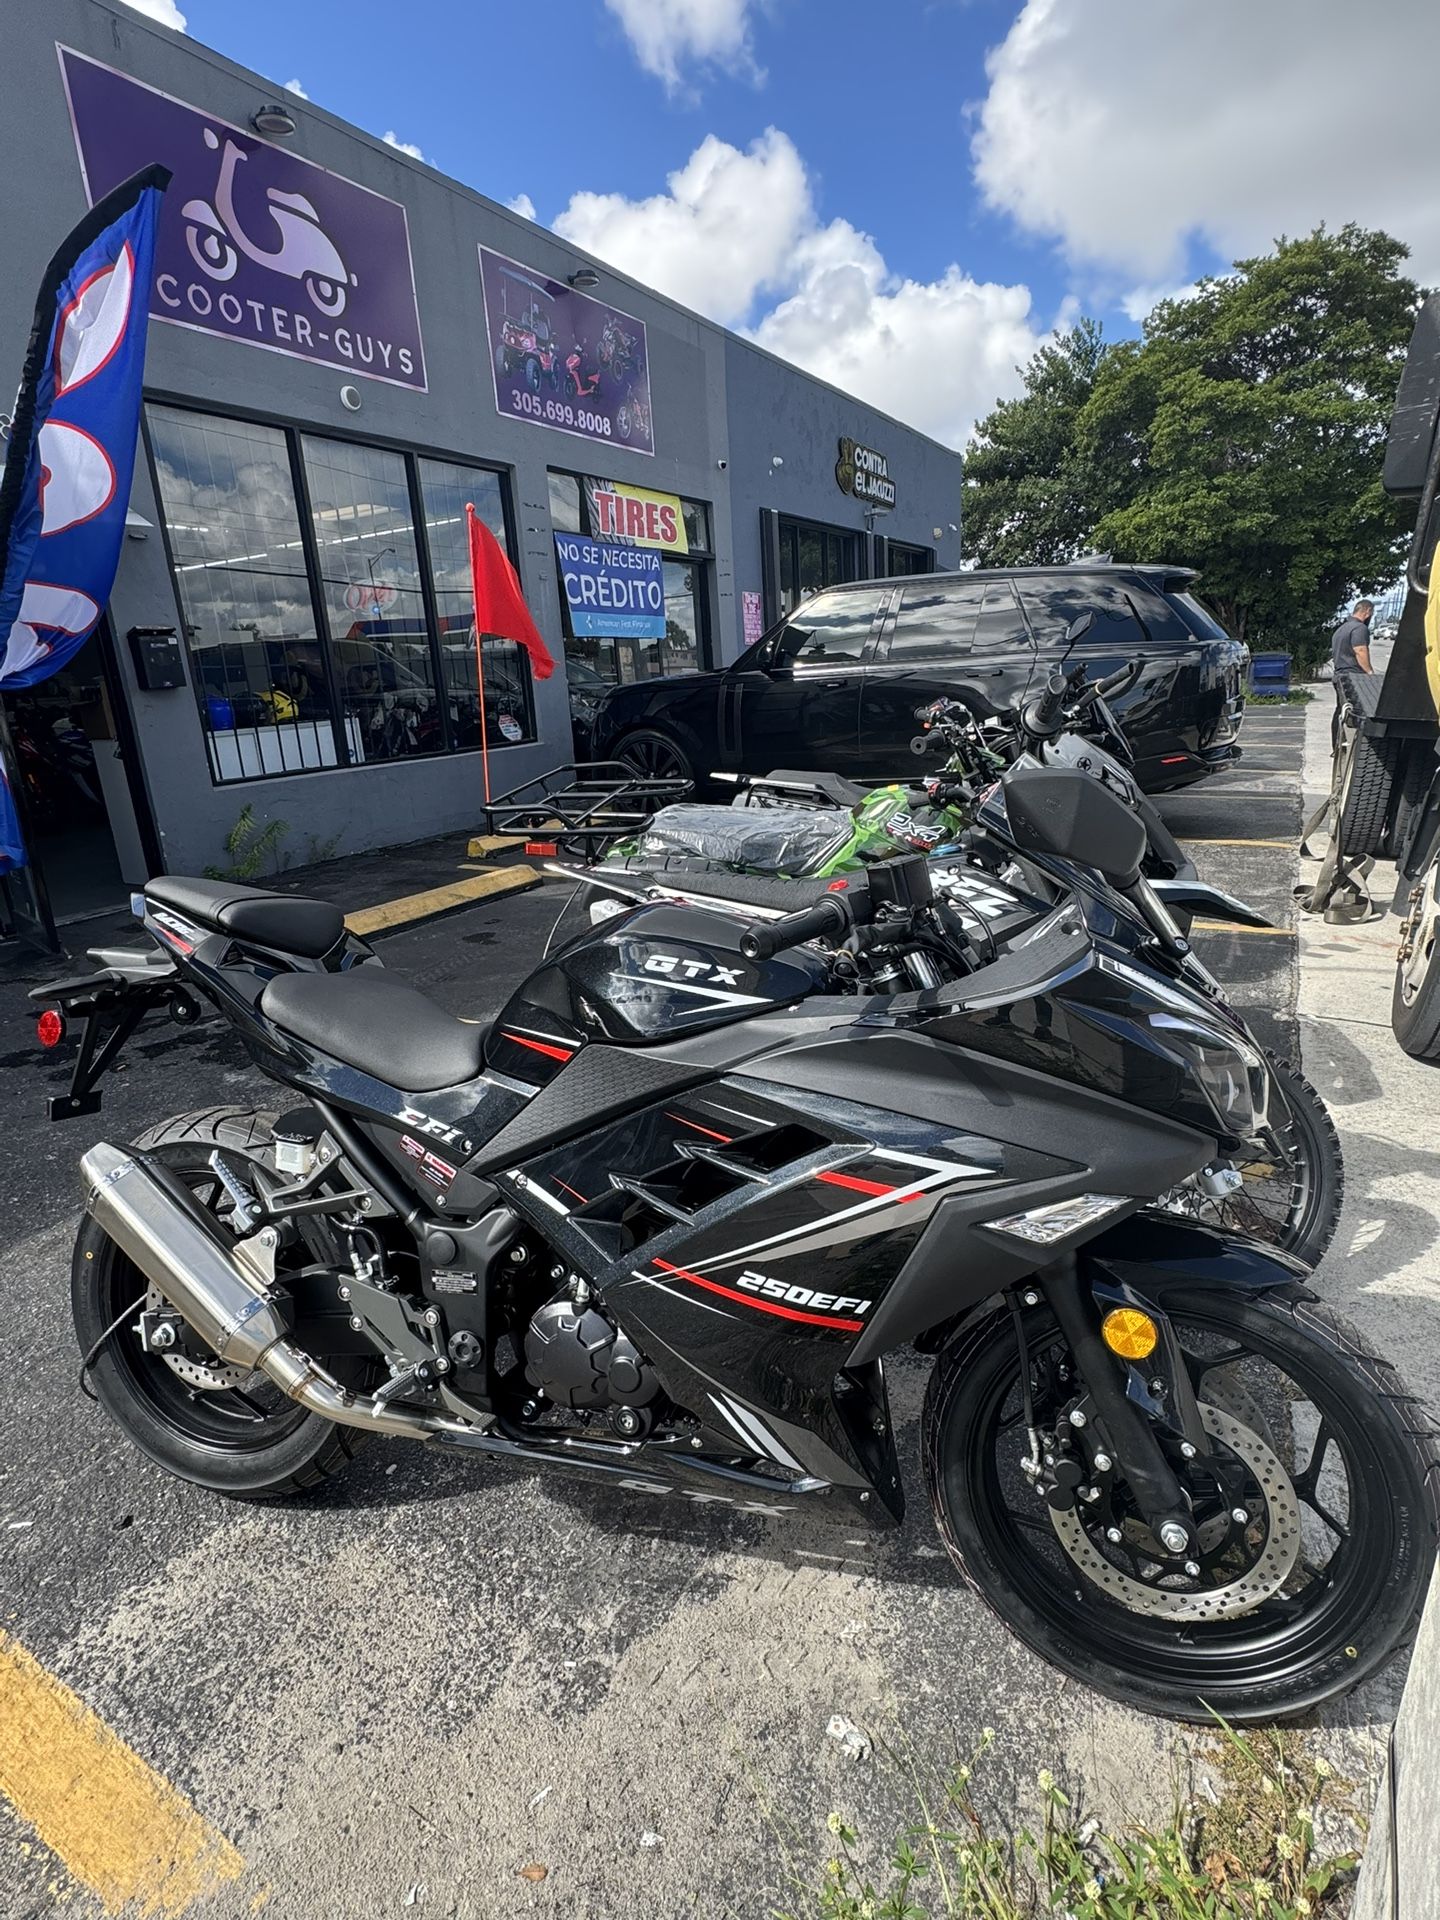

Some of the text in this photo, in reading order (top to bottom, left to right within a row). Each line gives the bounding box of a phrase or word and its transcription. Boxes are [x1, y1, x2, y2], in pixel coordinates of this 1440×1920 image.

[511, 389, 612, 436] 305.699.8008
[854, 446, 888, 478] CONTRA
[593, 490, 679, 545] TIRES
[557, 541, 661, 571] NO SE NECESITA
[564, 569, 662, 610] CRÉDITO
[644, 954, 746, 986] GTX
[736, 1270, 872, 1315] 250EFI
